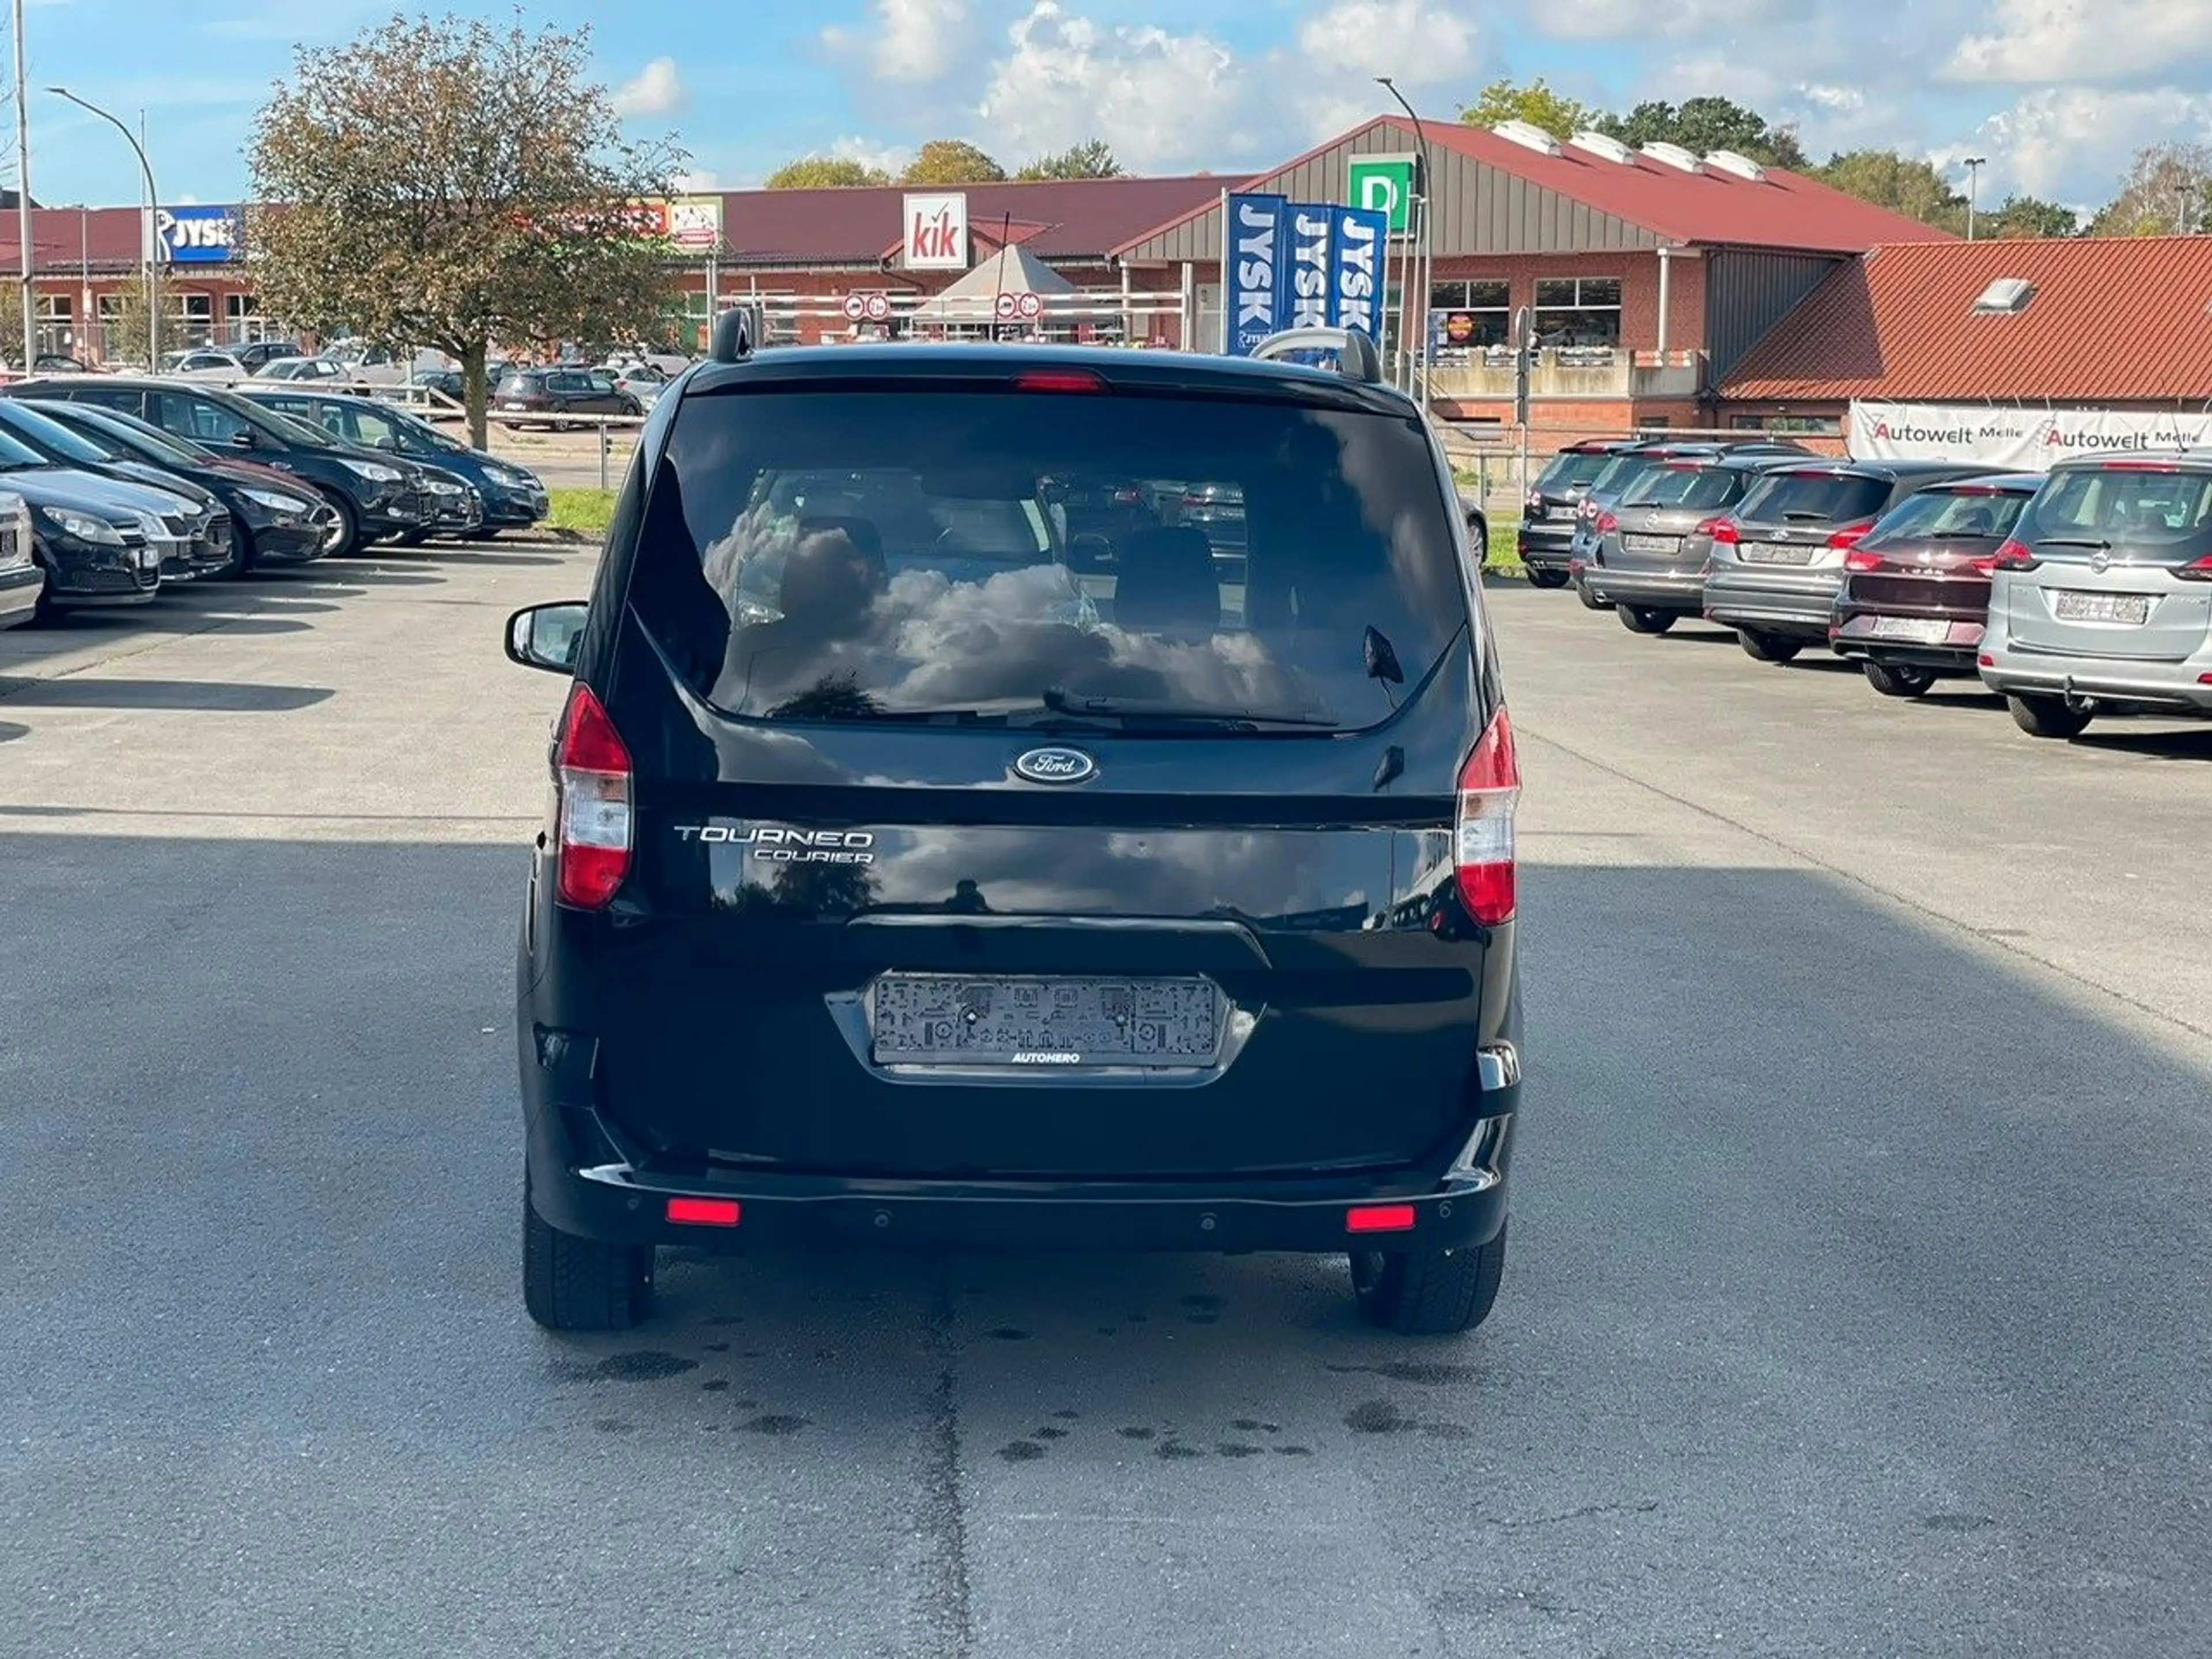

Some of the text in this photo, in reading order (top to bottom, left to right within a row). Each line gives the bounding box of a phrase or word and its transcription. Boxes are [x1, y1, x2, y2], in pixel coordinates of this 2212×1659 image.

[1239, 203, 1275, 329] JYSK
[1293, 213, 1327, 328] JYSK
[1339, 215, 1375, 333] JYSK
[1874, 423, 1973, 444] Autowelt
[2046, 430, 2149, 450] Autowelt
[673, 825, 873, 849] TOURNEO
[754, 849, 873, 864] COURIER
[1012, 1052, 1081, 1064] AUTOHERO
